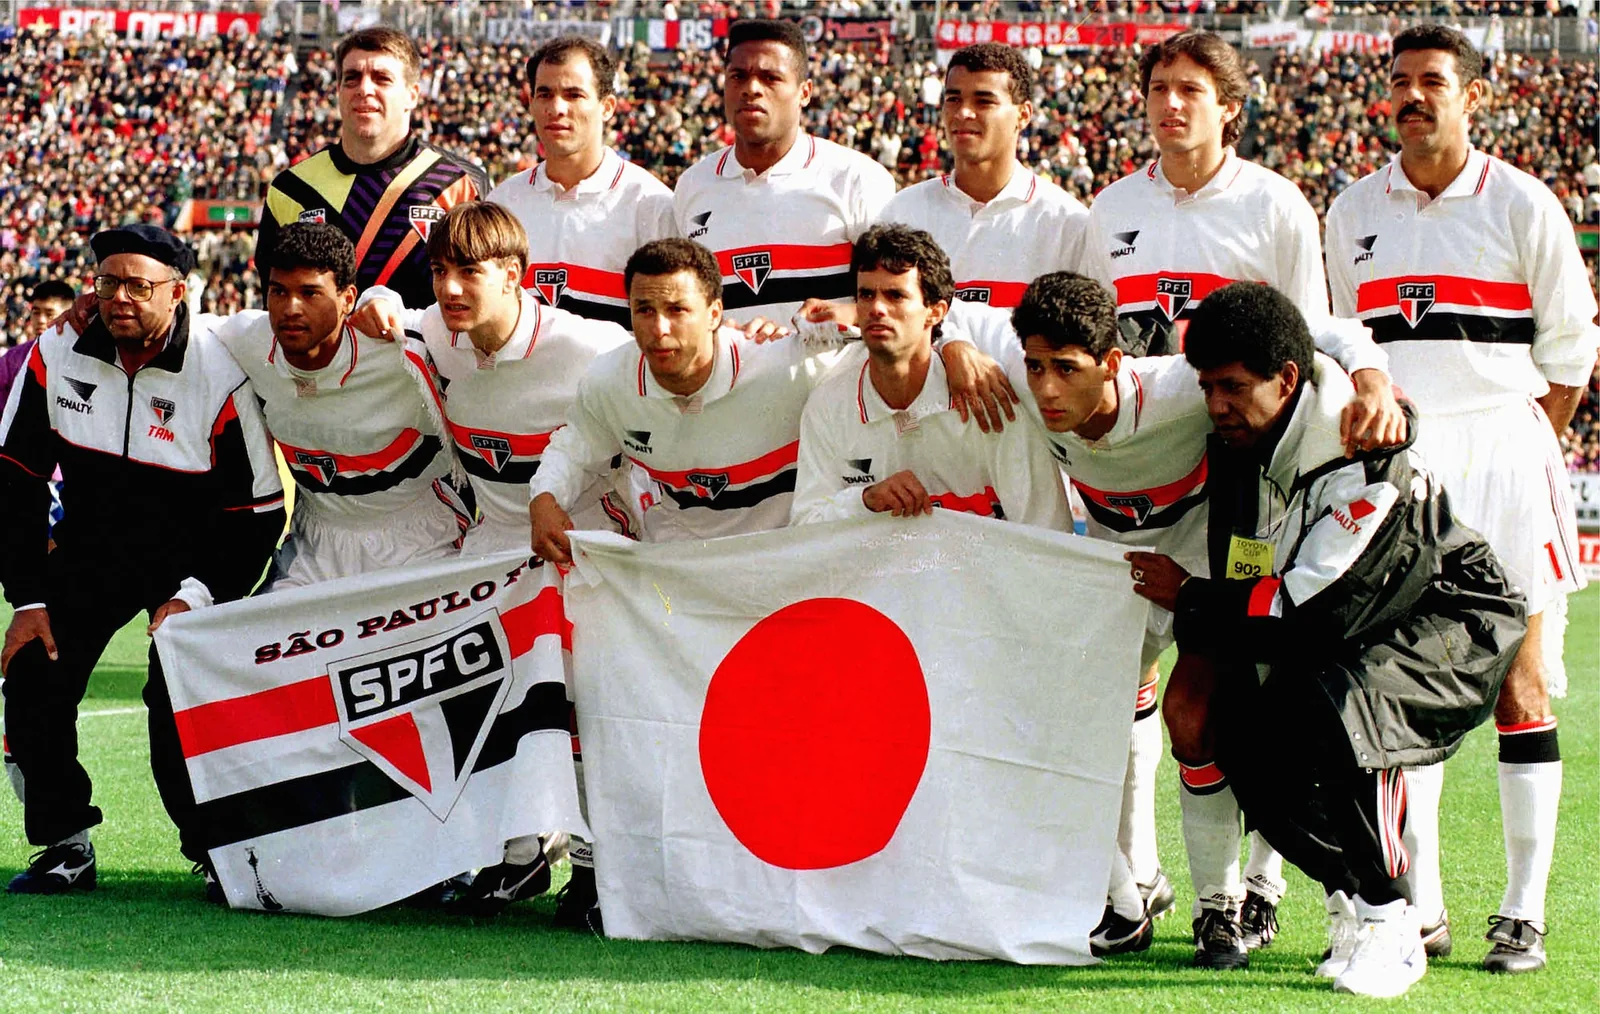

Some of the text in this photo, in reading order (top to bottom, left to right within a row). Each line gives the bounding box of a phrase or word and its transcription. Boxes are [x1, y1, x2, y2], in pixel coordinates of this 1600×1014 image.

[736, 255, 768, 268] SPFC
[1157, 282, 1188, 293] SPFC
[1401, 287, 1433, 297] SPFC
[56, 396, 92, 415] PENALTY
[147, 425, 174, 442] TAM
[475, 438, 507, 450] SPFC
[1236, 540, 1268, 552] TOYOTA
[1242, 548, 1261, 557] CUP
[1234, 561, 1261, 577] 902
[255, 629, 344, 665] SÃO
[357, 580, 497, 639] PAULO
[350, 631, 491, 713] SPFC
